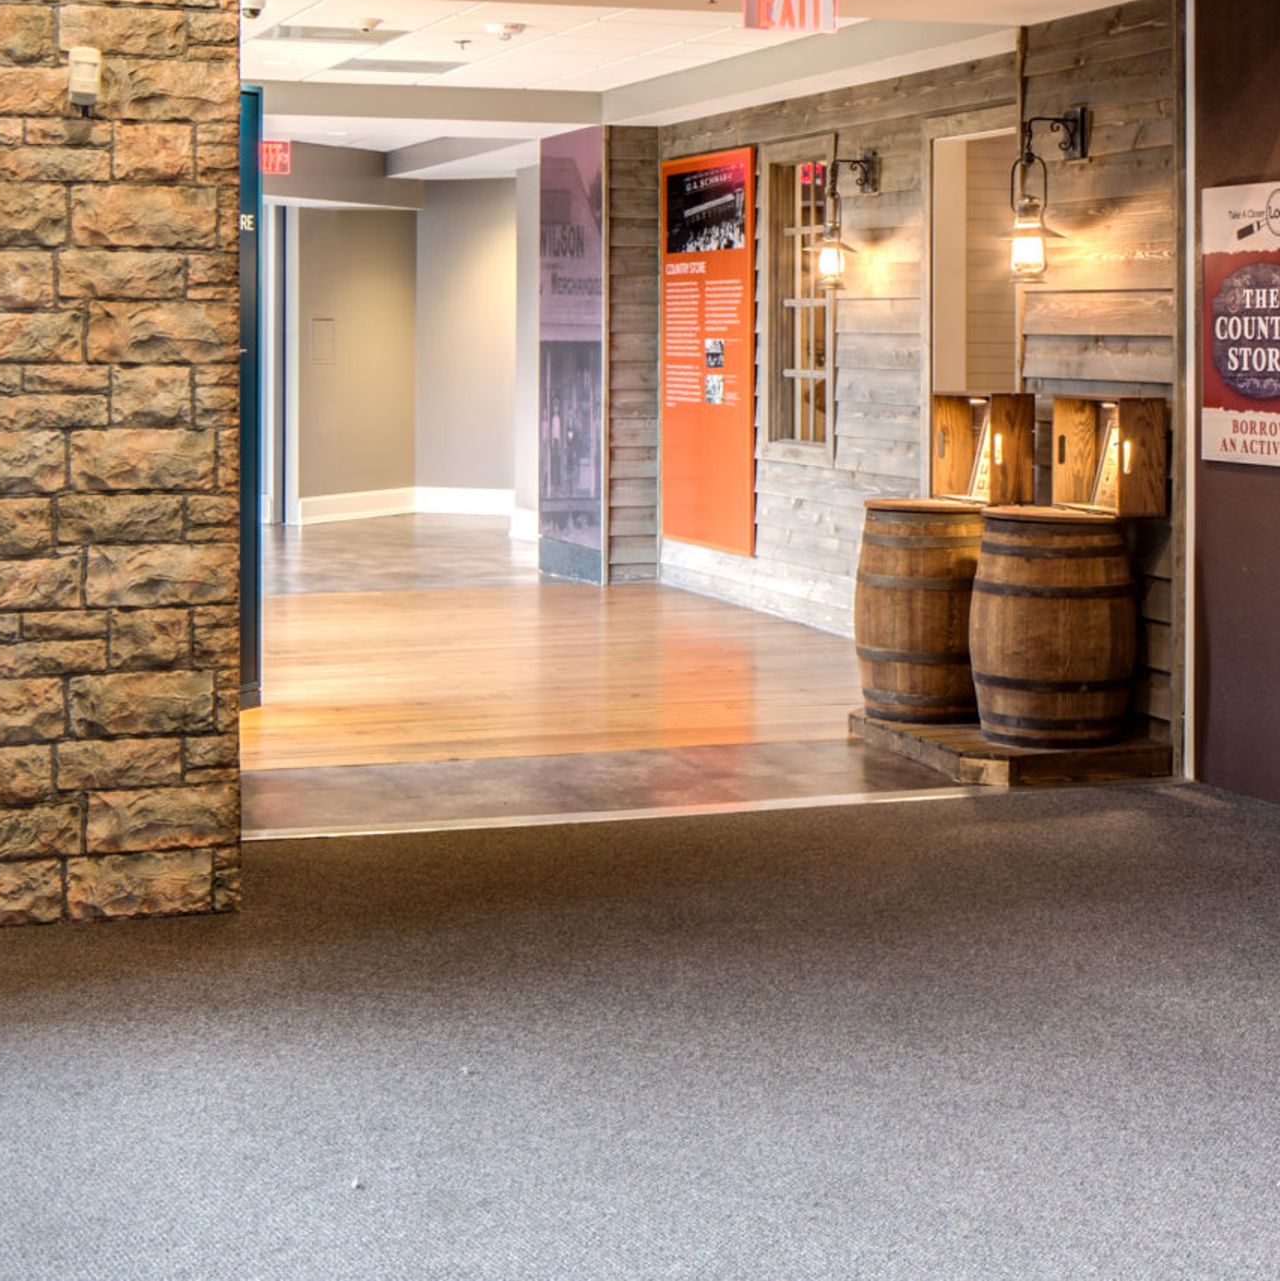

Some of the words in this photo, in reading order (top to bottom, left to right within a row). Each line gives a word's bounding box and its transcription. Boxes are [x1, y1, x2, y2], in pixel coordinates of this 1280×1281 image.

[240, 214, 255, 231] RE
[1243, 289, 1279, 309] THE
[1220, 438, 1236, 452] AN
